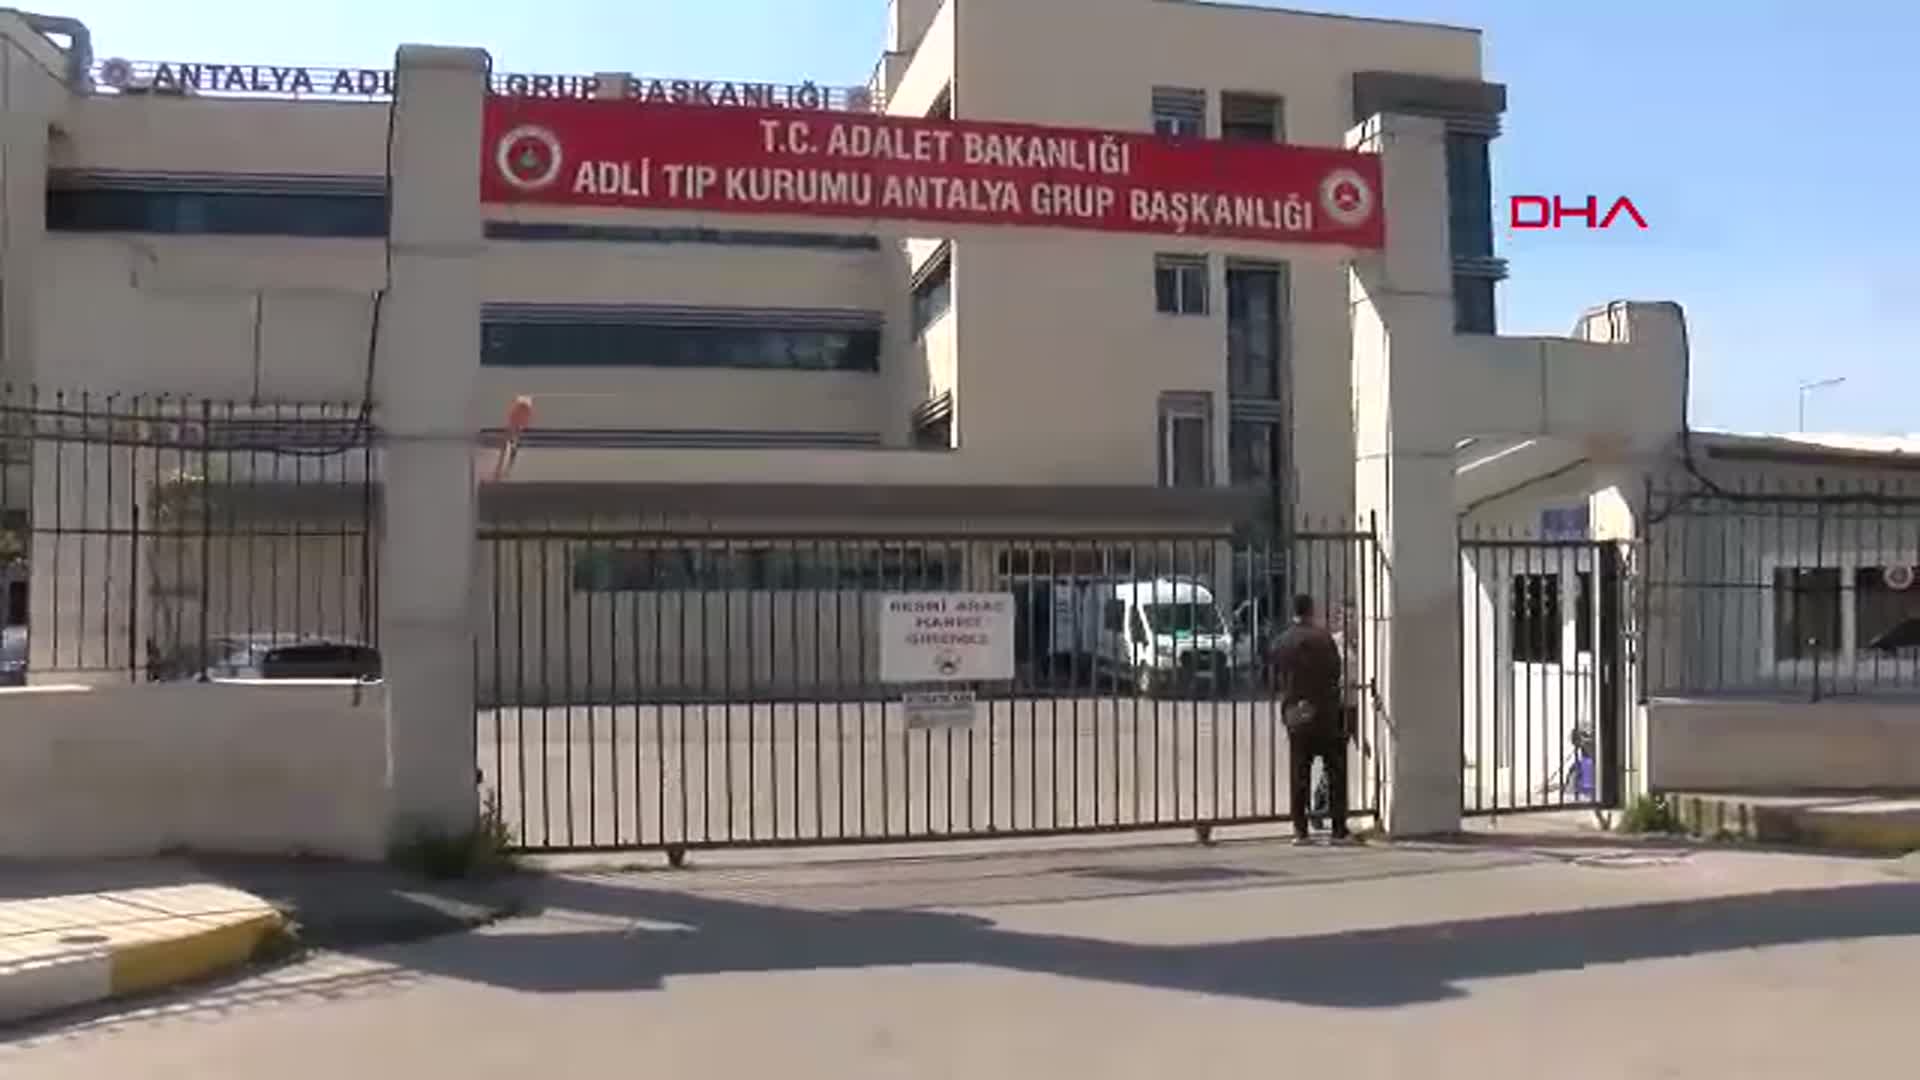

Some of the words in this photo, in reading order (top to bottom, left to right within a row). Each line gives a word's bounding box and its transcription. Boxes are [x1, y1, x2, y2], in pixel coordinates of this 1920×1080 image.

[152, 63, 314, 94] ANTALYA
[330, 70, 395, 95] ADL
[759, 119, 818, 154] T.C.
[827, 124, 952, 162] ADALET
[964, 130, 1130, 174] BAKANLIĞI
[573, 157, 650, 197] ADLİ
[663, 164, 717, 200] TIP
[725, 168, 872, 207] KURUMU
[881, 174, 1021, 214] ANTALYA
[1030, 182, 1115, 218] GRUP
[1130, 189, 1313, 233] BAŞKANLIĞI
